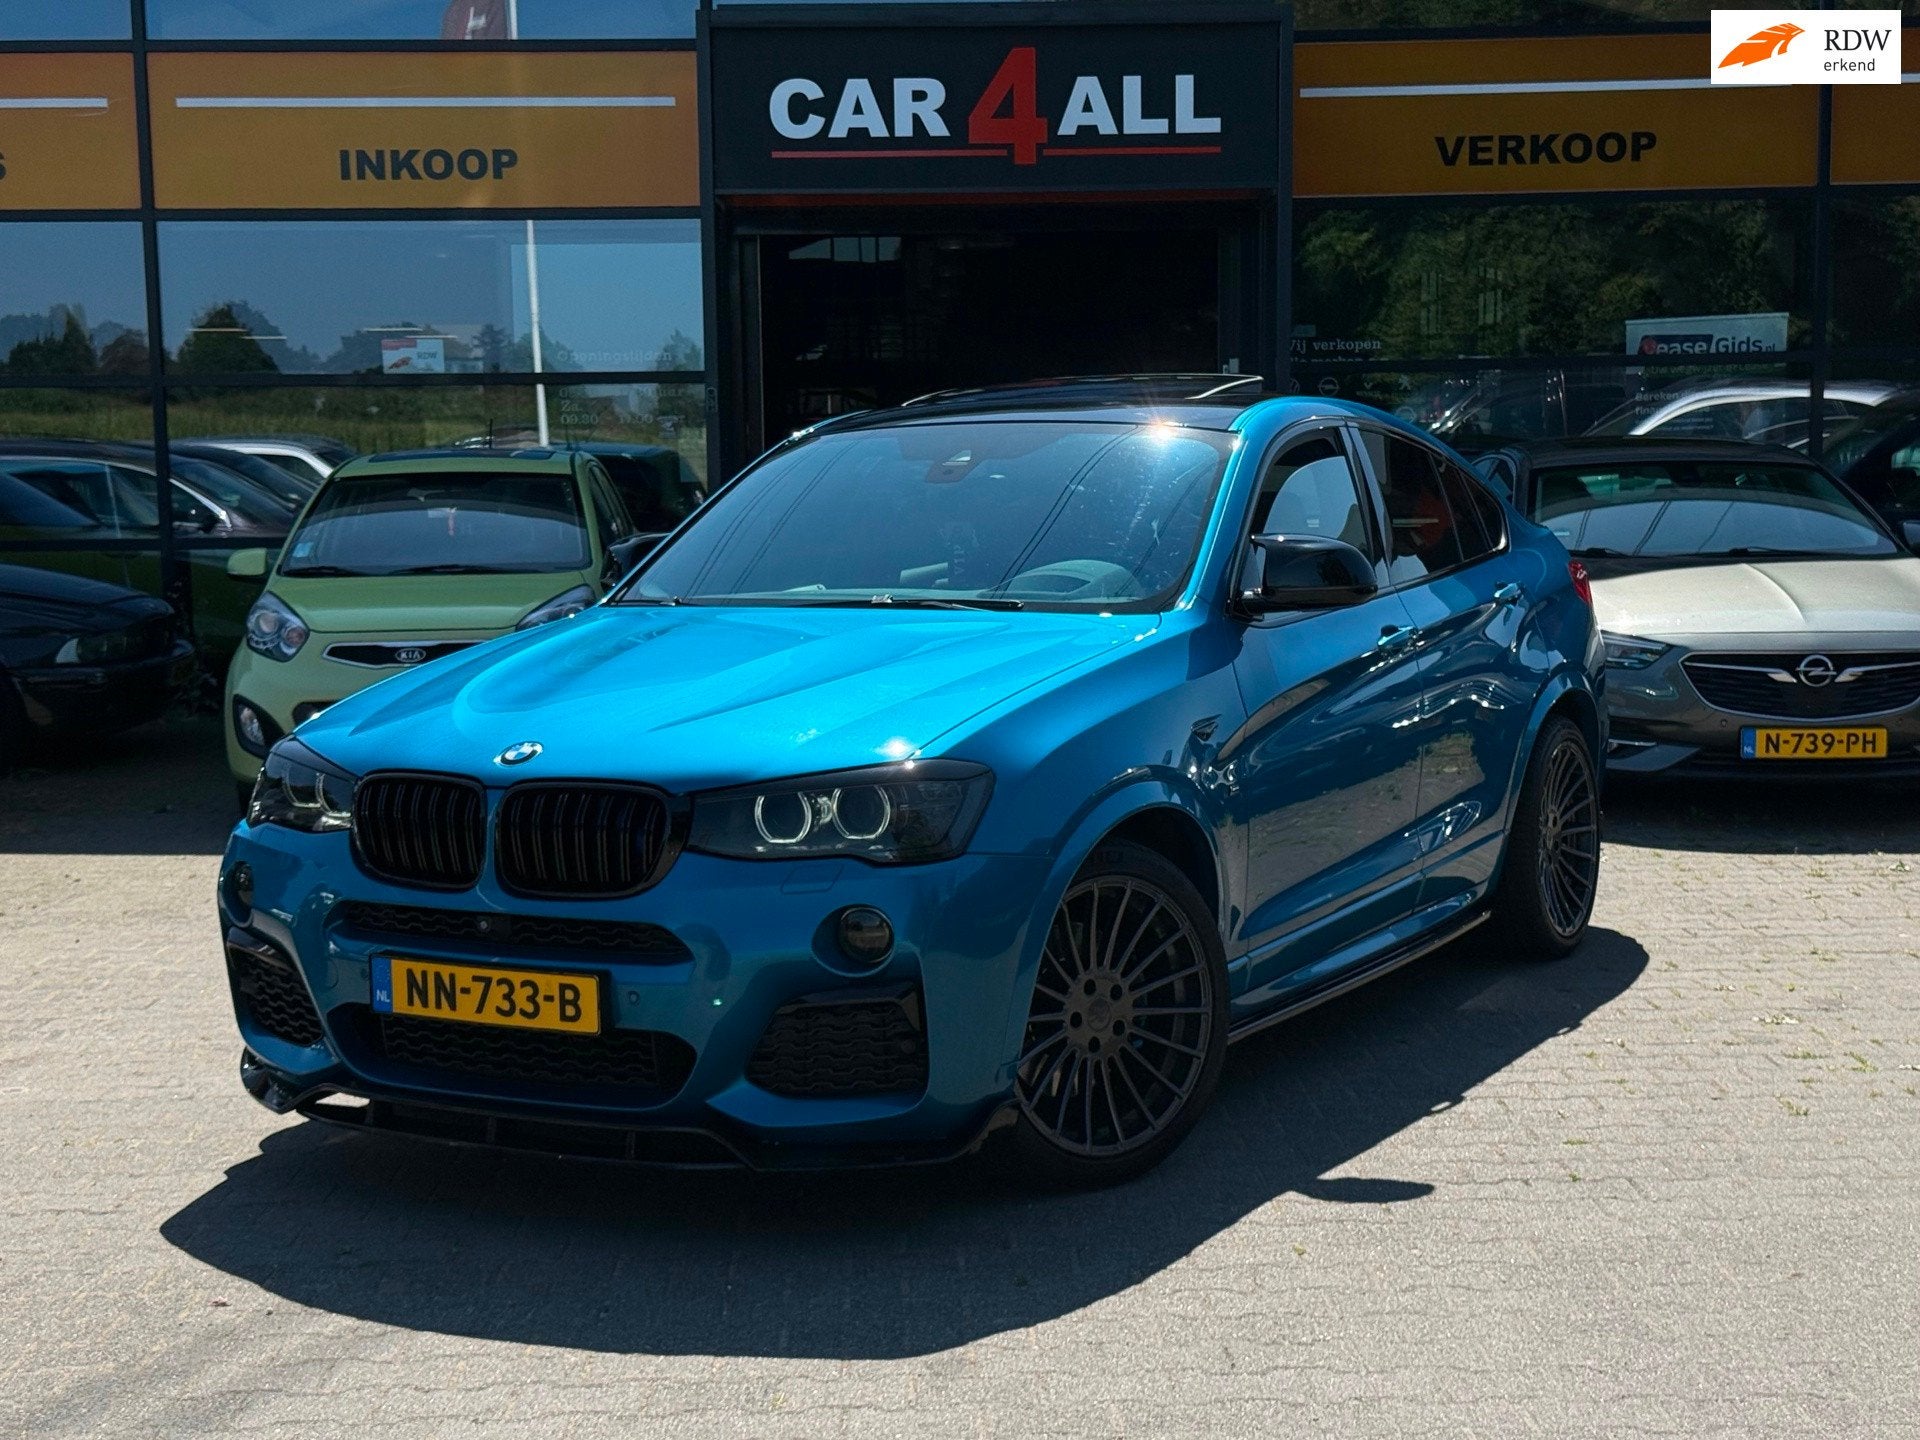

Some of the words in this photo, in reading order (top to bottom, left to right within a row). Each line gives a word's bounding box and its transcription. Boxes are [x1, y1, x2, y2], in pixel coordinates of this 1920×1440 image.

[769, 78, 950, 139] CAR
[968, 47, 1049, 165] 4
[1057, 75, 1222, 136] ALL
[338, 148, 518, 181] INKOOP
[1434, 131, 1657, 167] VERKOOP
[1312, 338, 1382, 353] verkopen
[400, 650, 421, 661] KIA
[1764, 732, 1878, 754] N-739-PH
[376, 989, 391, 1003] NL
[405, 968, 582, 1023] NN-733-B
